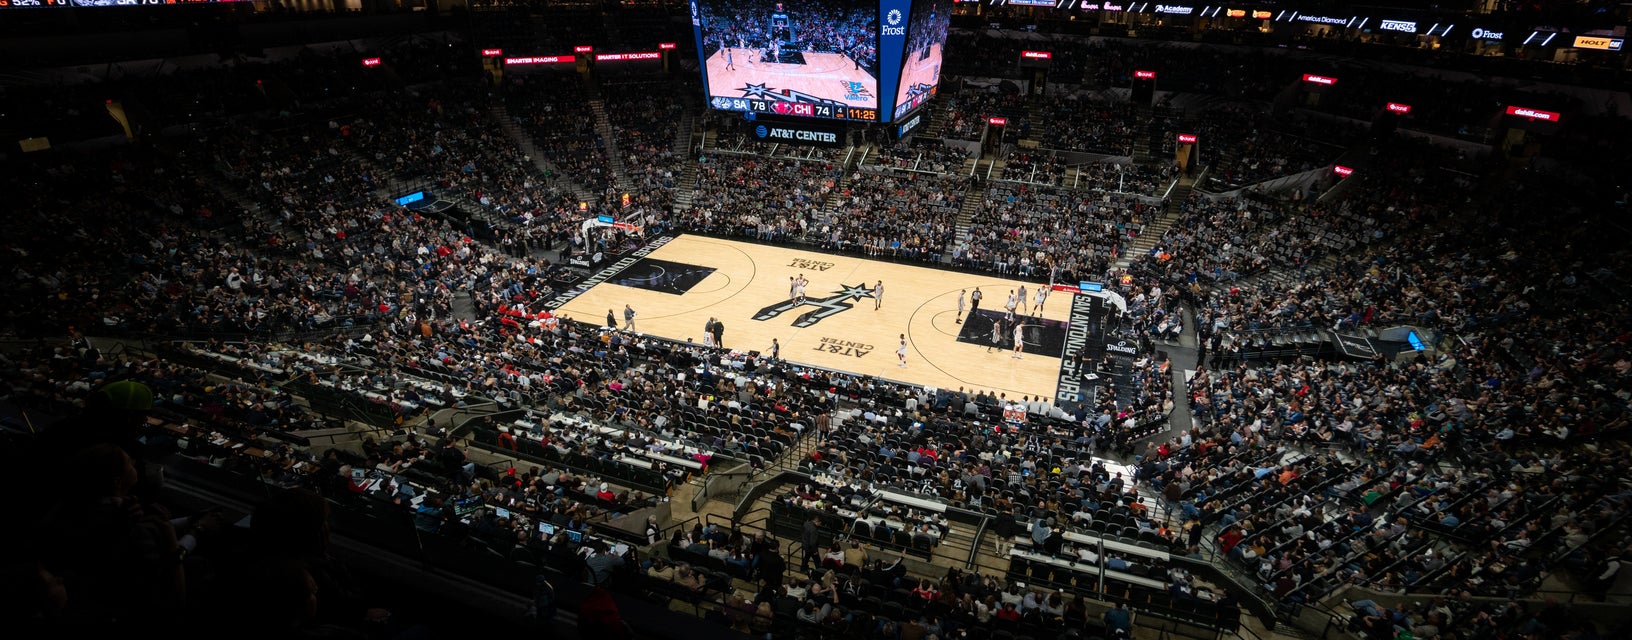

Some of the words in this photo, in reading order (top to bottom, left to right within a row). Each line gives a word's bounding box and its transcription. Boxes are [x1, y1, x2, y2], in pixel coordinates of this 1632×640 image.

[1164, 5, 1193, 14] Academy
[1321, 16, 1347, 24] Diamond
[881, 25, 904, 35] Frost
[1482, 30, 1503, 39] Frost
[628, 52, 658, 60] SOLUTIONS
[733, 101, 747, 110] SA
[752, 101, 766, 111] 78
[794, 104, 812, 115] CHI
[815, 106, 830, 116] 74
[849, 109, 875, 120] 11:25
[1514, 108, 1550, 119] dahill.com
[770, 128, 794, 138] AT&T
[796, 130, 836, 142] CENTER
[786, 262, 831, 271] AT&T
[792, 258, 835, 267] CENTER
[544, 288, 582, 308] SAN
[575, 257, 638, 295] ANTONIO
[632, 235, 674, 257] SPURS
[1073, 295, 1091, 313] SAN
[820, 337, 874, 350] CENTER
[812, 343, 871, 358] AT&T
[1106, 343, 1136, 355] SPALDING
